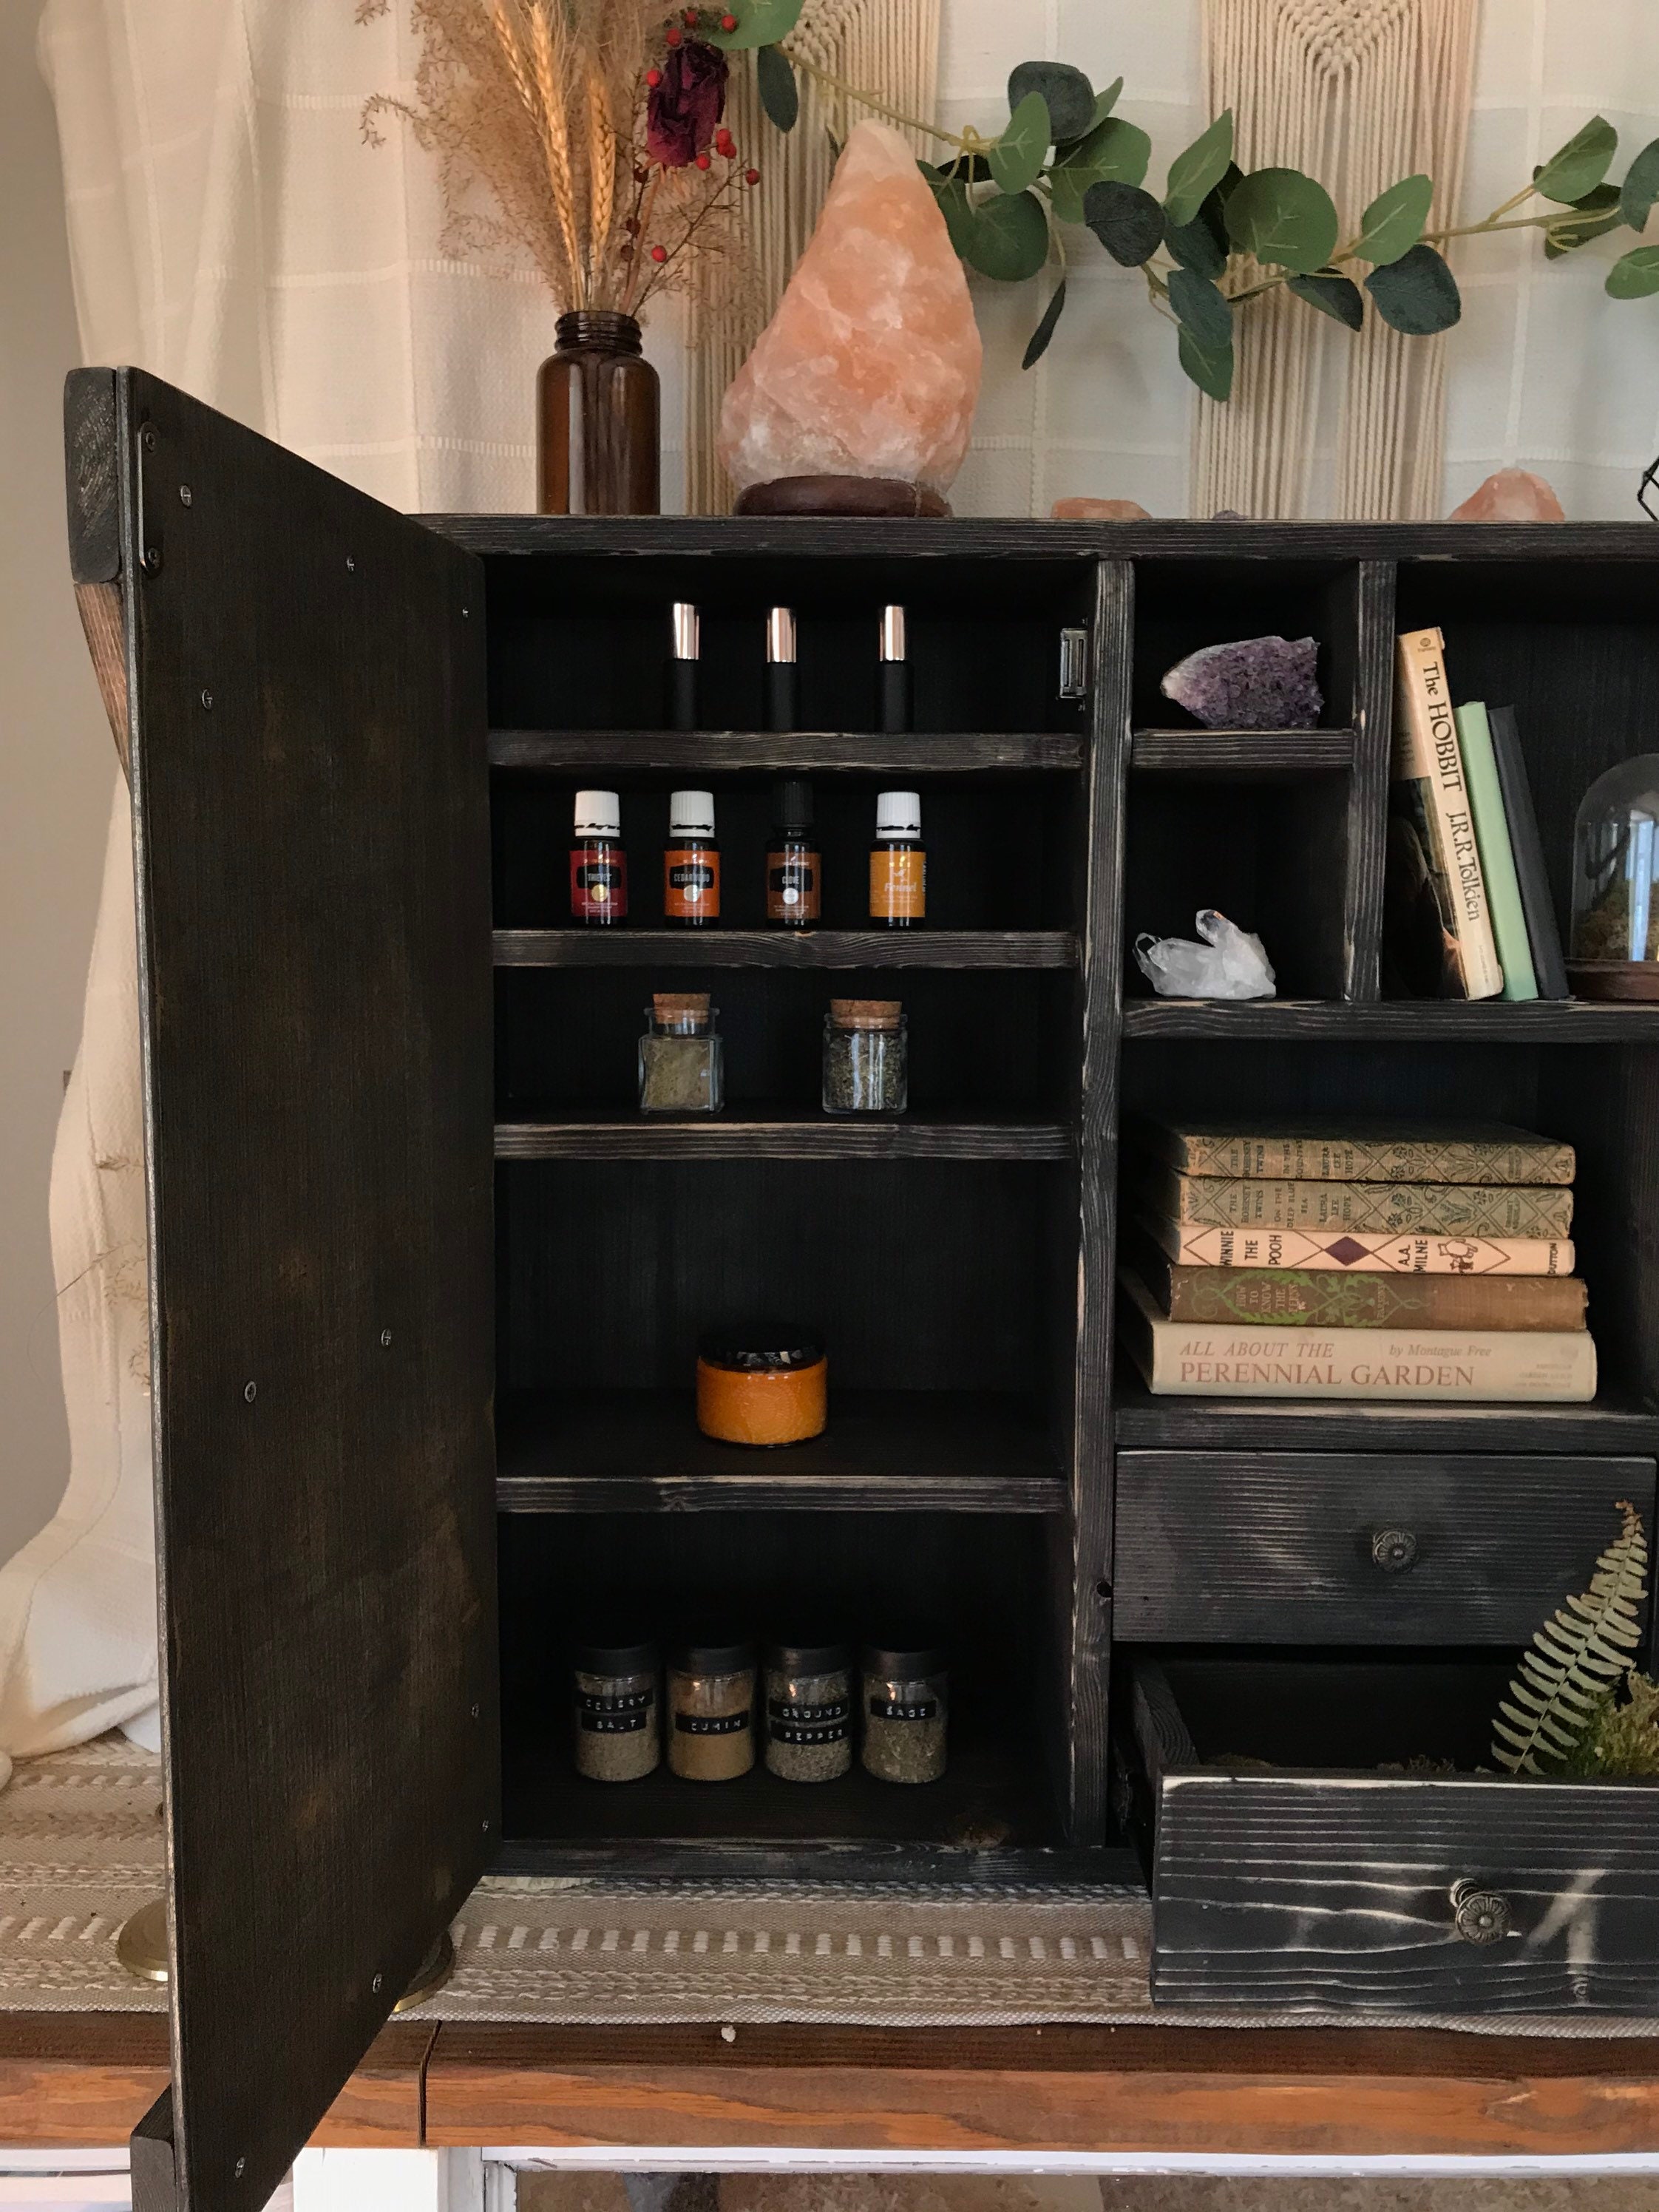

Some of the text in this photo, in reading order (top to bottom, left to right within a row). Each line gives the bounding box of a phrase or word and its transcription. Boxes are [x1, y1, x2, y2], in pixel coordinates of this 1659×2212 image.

[1422, 662, 1440, 696] The
[1428, 701, 1462, 792] HOBBIT
[1446, 810, 1481, 921] J.R.R. Tolkien
[1230, 1149, 1238, 1168] THE
[1283, 1164, 1290, 1175] IN
[1321, 1146, 1329, 1177] LAURA
[1345, 1149, 1354, 1174] HOPE
[1229, 1193, 1238, 1213] THE
[1255, 1190, 1264, 1218] TWINS
[1275, 1187, 1283, 1223] ON THE
[1287, 1182, 1295, 1204] BLUE
[1320, 1192, 1329, 1224] LAURA
[1331, 1199, 1340, 1216] LEE
[1343, 1195, 1351, 1221] HOPE
[1220, 1230, 1234, 1266] WINNIE
[1245, 1240, 1258, 1261] THE
[1269, 1235, 1282, 1265] POOH
[1413, 1239, 1428, 1273] MILNE
[1547, 1242, 1558, 1275] DUTTON
[1236, 1284, 1246, 1307] HOW
[1249, 1291, 1258, 1308] TO
[1261, 1282, 1272, 1313] KNOW
[1275, 1288, 1285, 1308] THE
[1289, 1284, 1299, 1313] FERNS
[1180, 1340, 1335, 1358] ALL ABOUT THE
[1389, 1344, 1492, 1359] by Montague Free
[1181, 1361, 1474, 1388] PERENNIAL GARDEN
[782, 1706, 841, 1719] GROUND
[887, 1706, 926, 1718] SAGE
[691, 1719, 742, 1731] CUMIN
